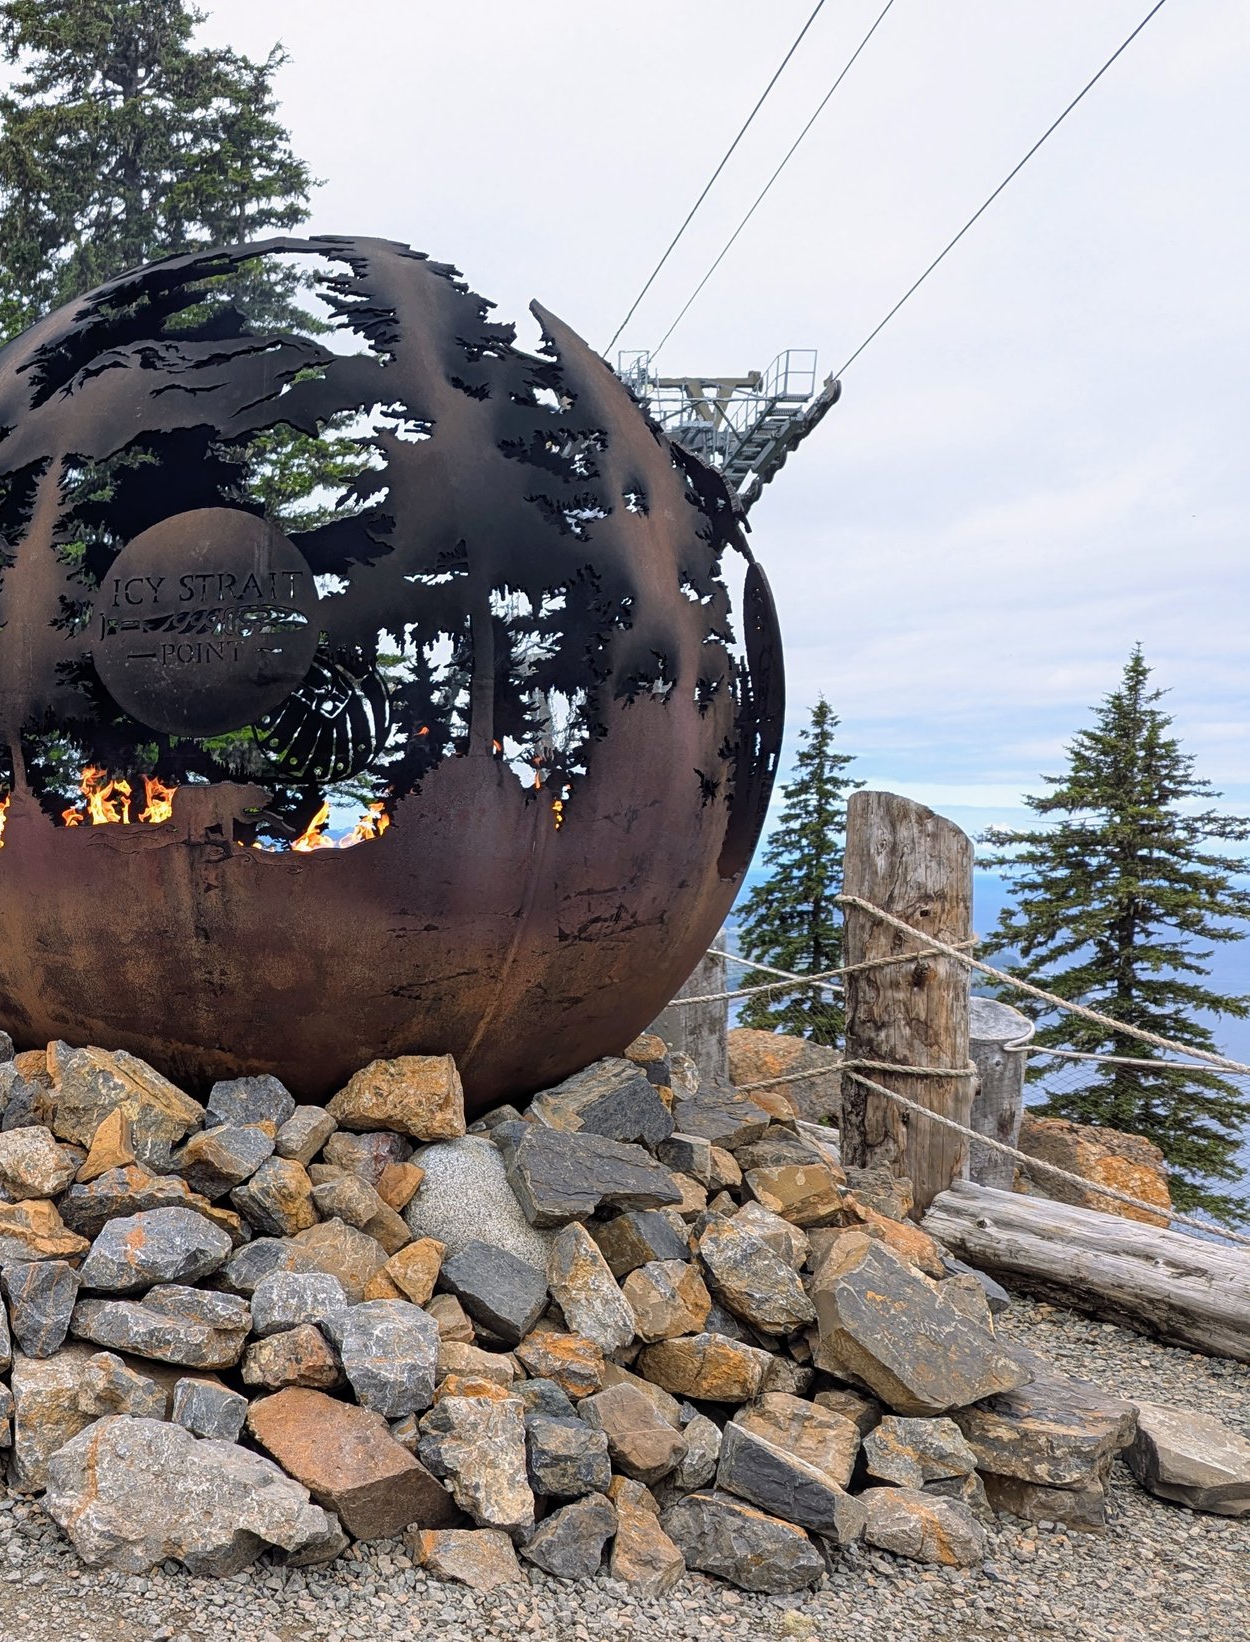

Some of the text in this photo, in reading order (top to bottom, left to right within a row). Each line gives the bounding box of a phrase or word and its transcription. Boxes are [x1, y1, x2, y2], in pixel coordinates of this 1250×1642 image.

[112, 571, 304, 607] ICY STRAIT
[161, 640, 245, 666] POINT
